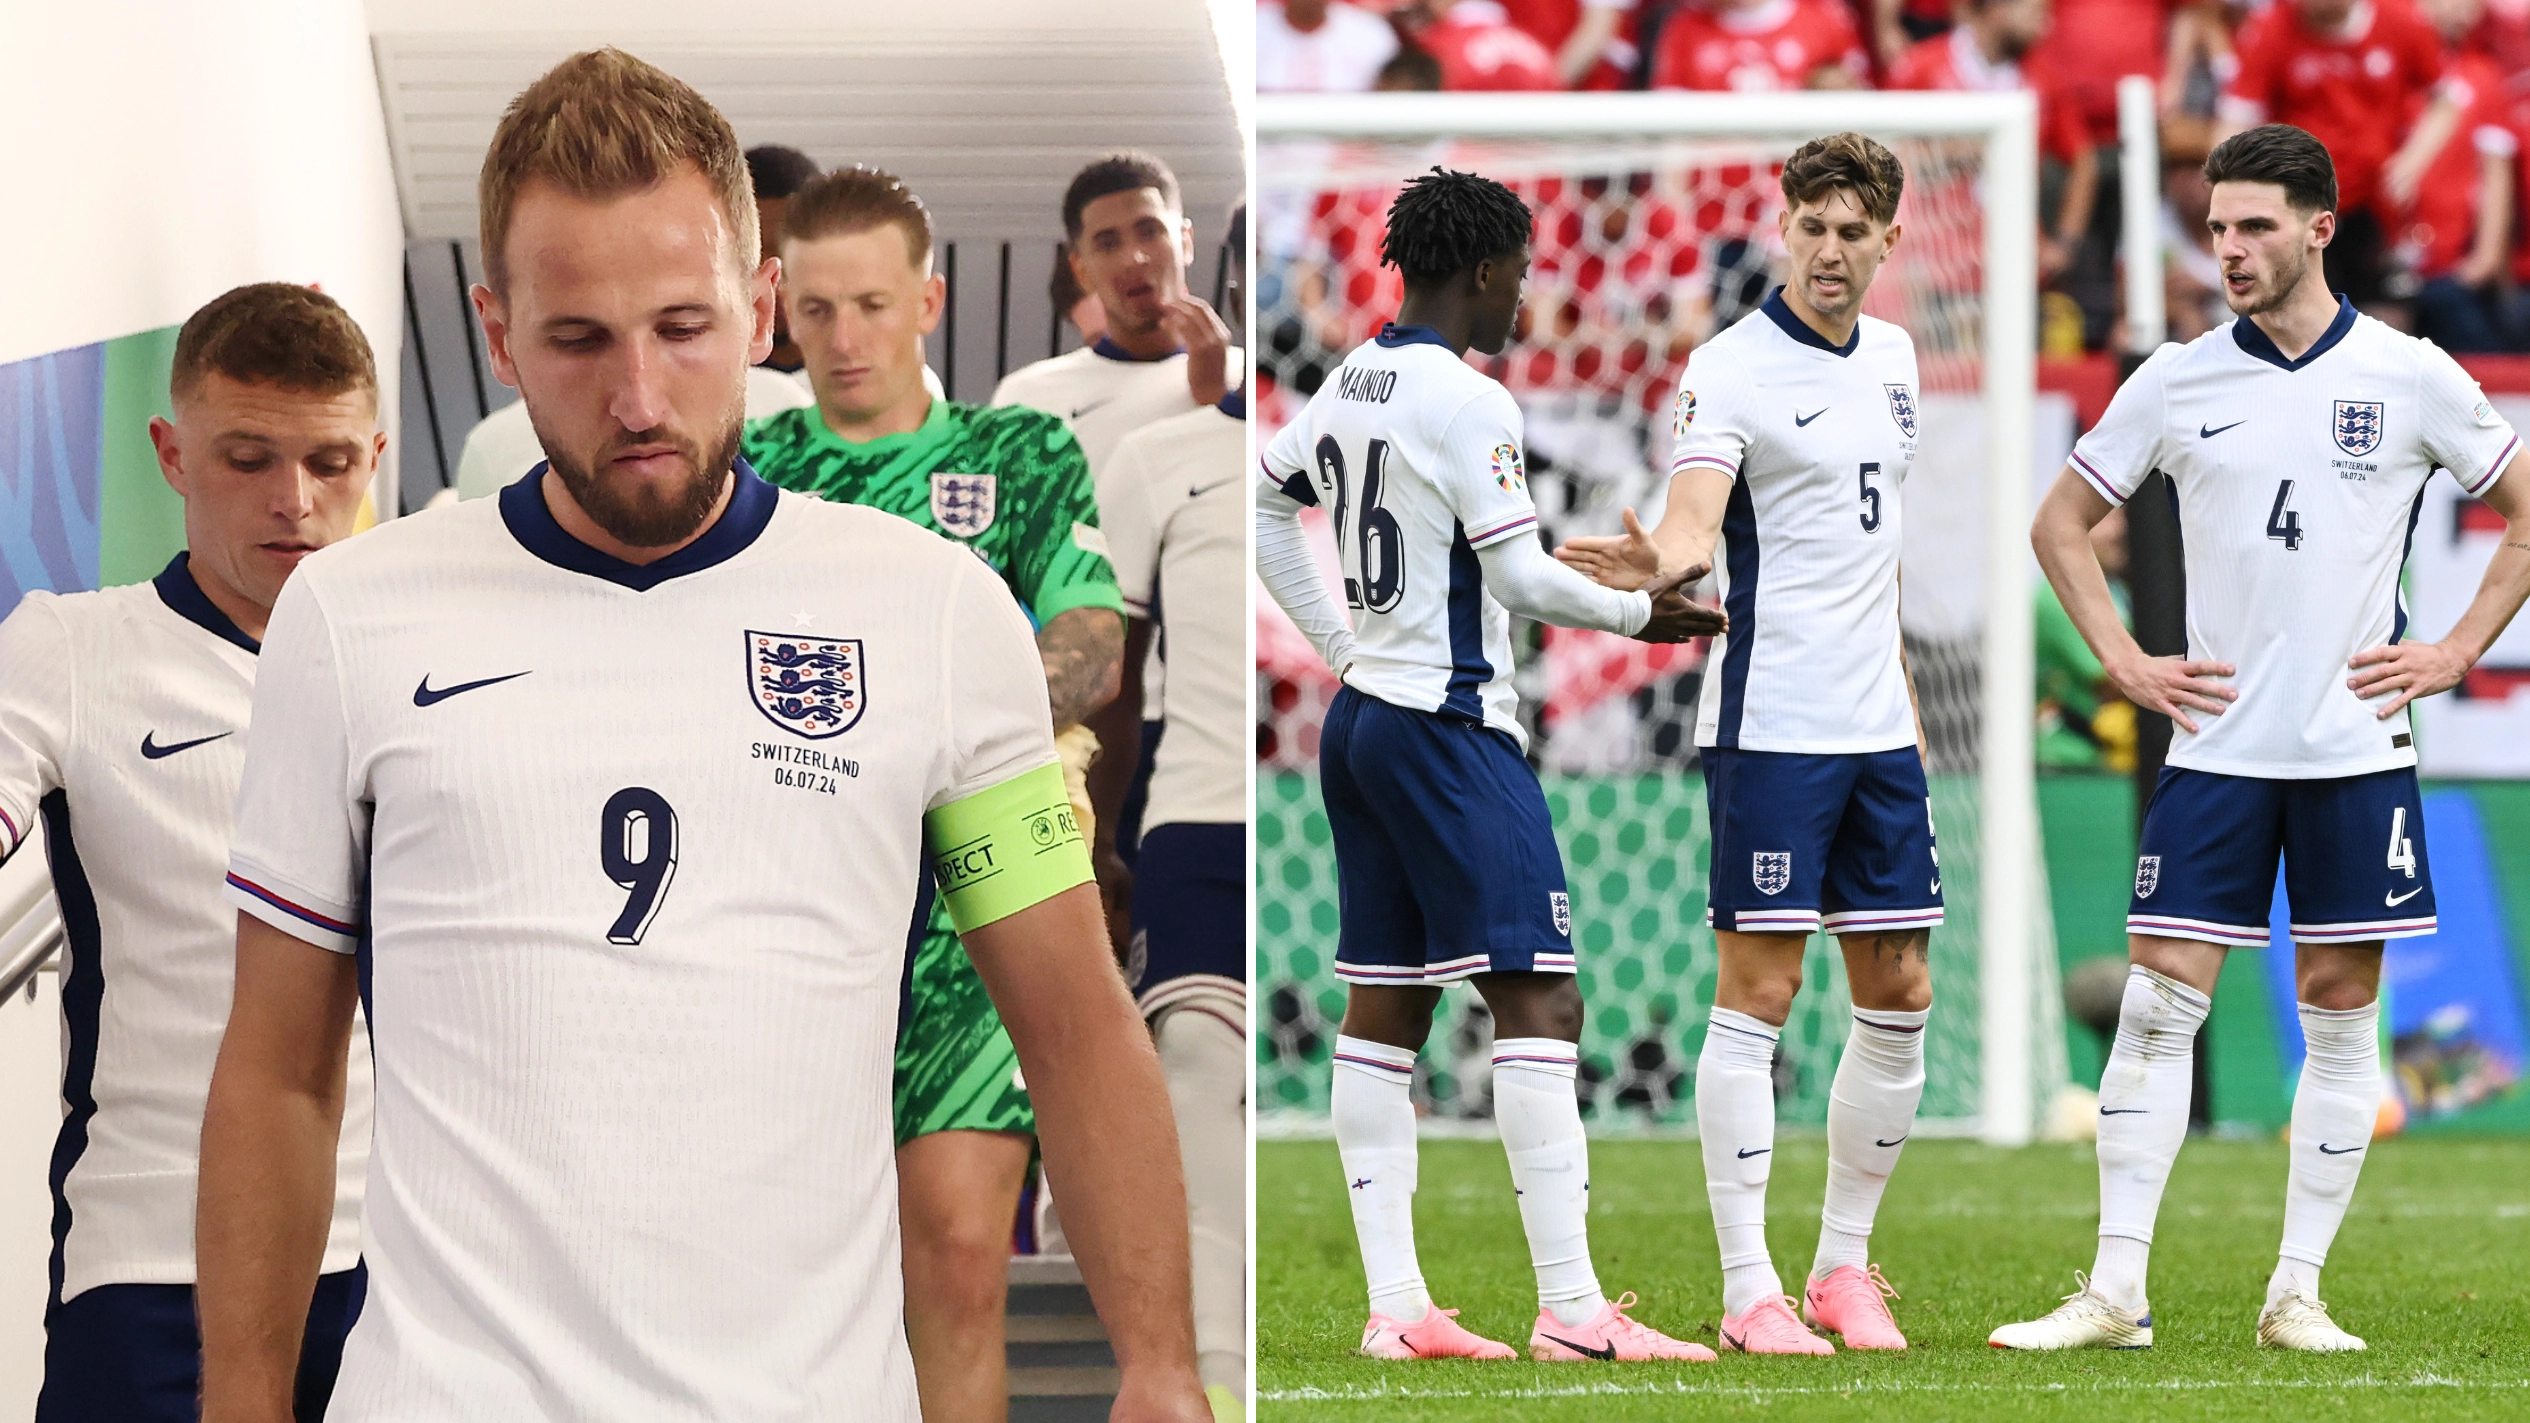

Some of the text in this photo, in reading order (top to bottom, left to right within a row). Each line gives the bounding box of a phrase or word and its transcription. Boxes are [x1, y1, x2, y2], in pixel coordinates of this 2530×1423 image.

[1335, 365, 1397, 404] MAINOO
[2331, 459, 2378, 473] SWITZERLAND
[2340, 471, 2367, 481] 06.07.24
[1859, 462, 1882, 534] 5
[2267, 479, 2303, 551] 4
[1316, 433, 1405, 615] 26
[751, 742, 860, 778] SWITZERLAND
[774, 767, 836, 796] 06.07.24
[1057, 812, 1080, 834] RE
[2387, 807, 2416, 878] 4
[601, 787, 679, 945] 9
[936, 843, 994, 886] SPECT
